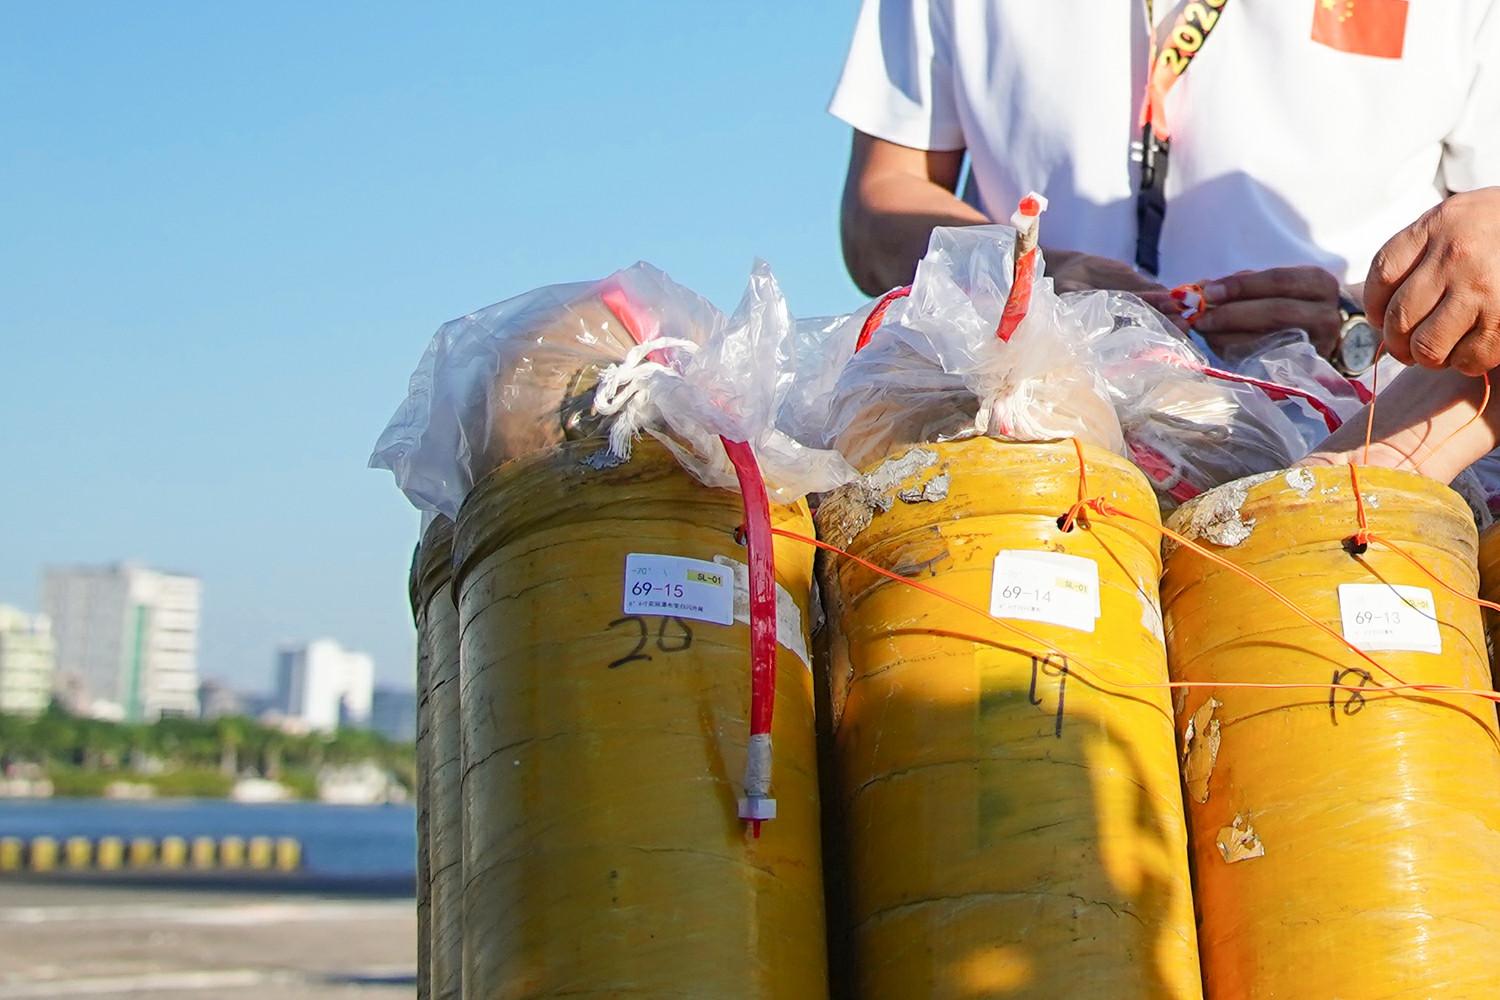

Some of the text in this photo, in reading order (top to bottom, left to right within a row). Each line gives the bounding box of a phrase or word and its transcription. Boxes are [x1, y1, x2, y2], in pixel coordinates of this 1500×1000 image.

[697, 572, 721, 585] SL-01
[1064, 579, 1088, 594] SL-01
[631, 581, 684, 598] 69-15
[1002, 585, 1051, 603] 69-14
[1355, 611, 1401, 625] 69-13
[604, 615, 693, 669] 20
